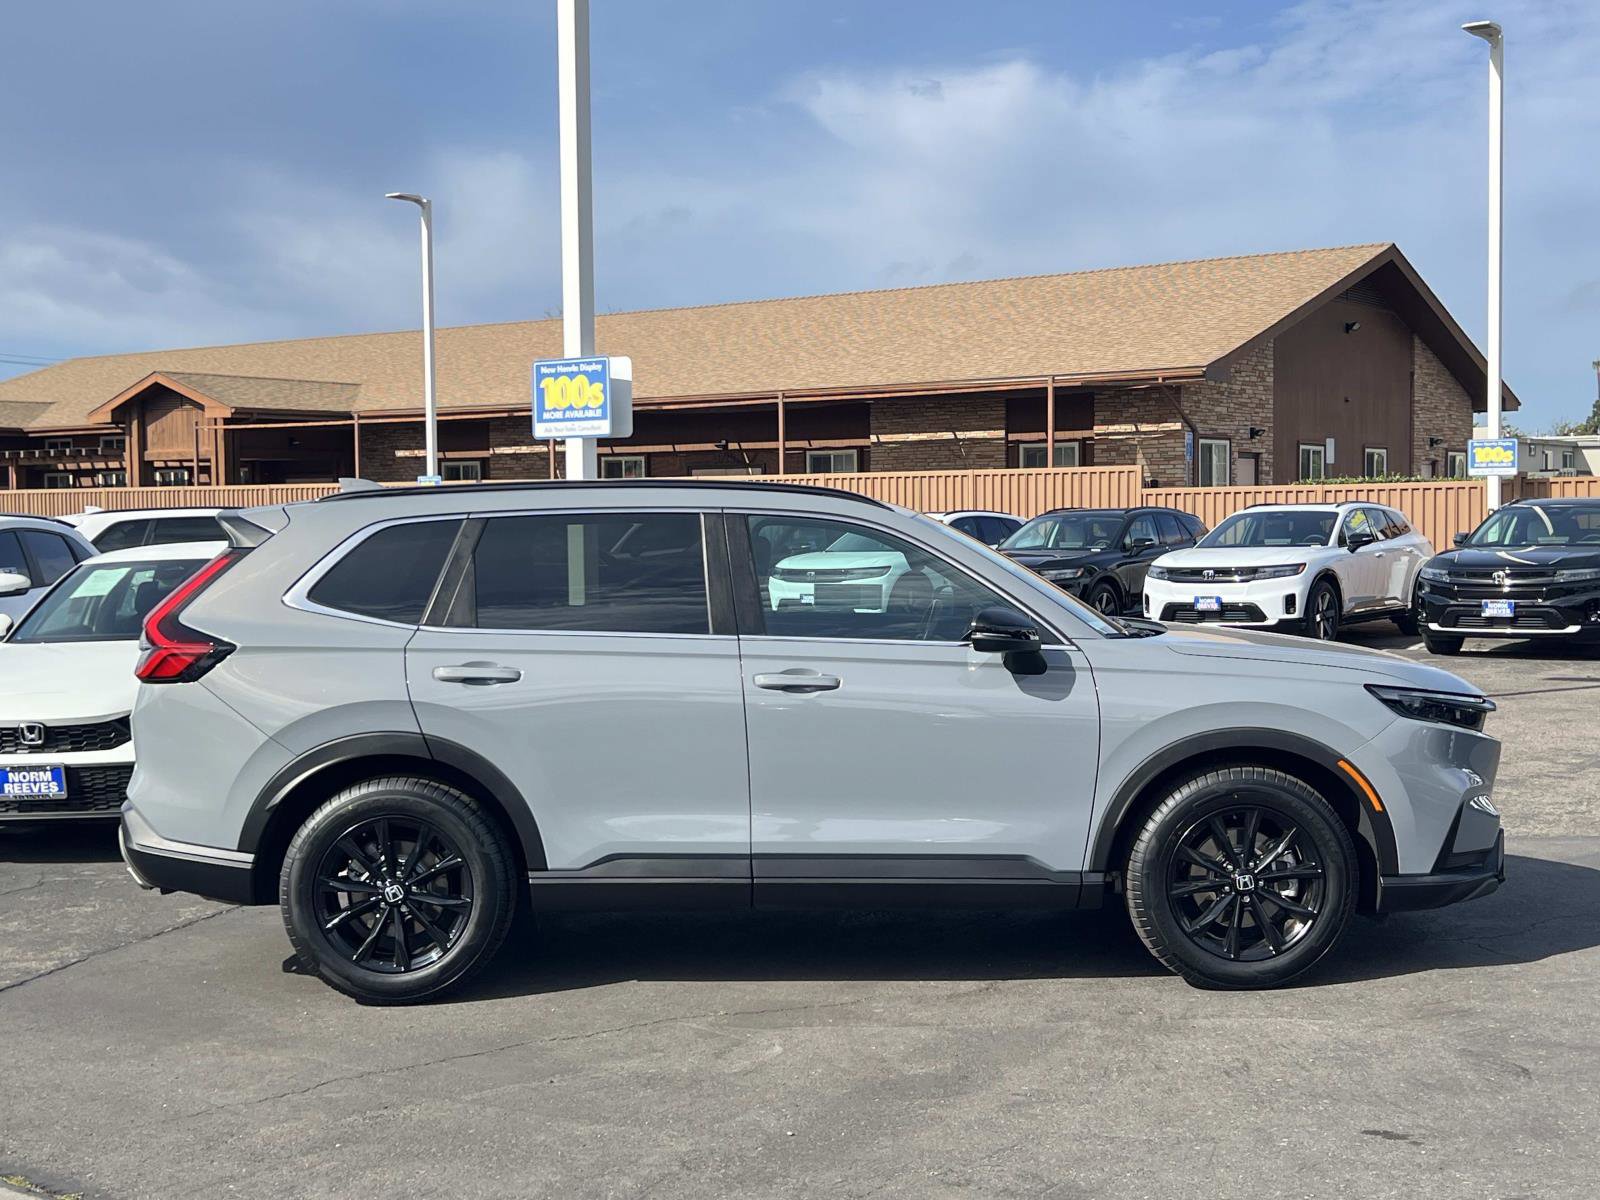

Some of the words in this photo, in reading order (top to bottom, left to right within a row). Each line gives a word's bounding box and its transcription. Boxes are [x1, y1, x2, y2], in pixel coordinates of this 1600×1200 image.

[541, 366, 556, 374] New
[580, 363, 602, 372] Display
[540, 374, 604, 410] 100s
[543, 411, 564, 420] MORE
[8, 771, 52, 782] NORM
[4, 782, 59, 794] REEVES
